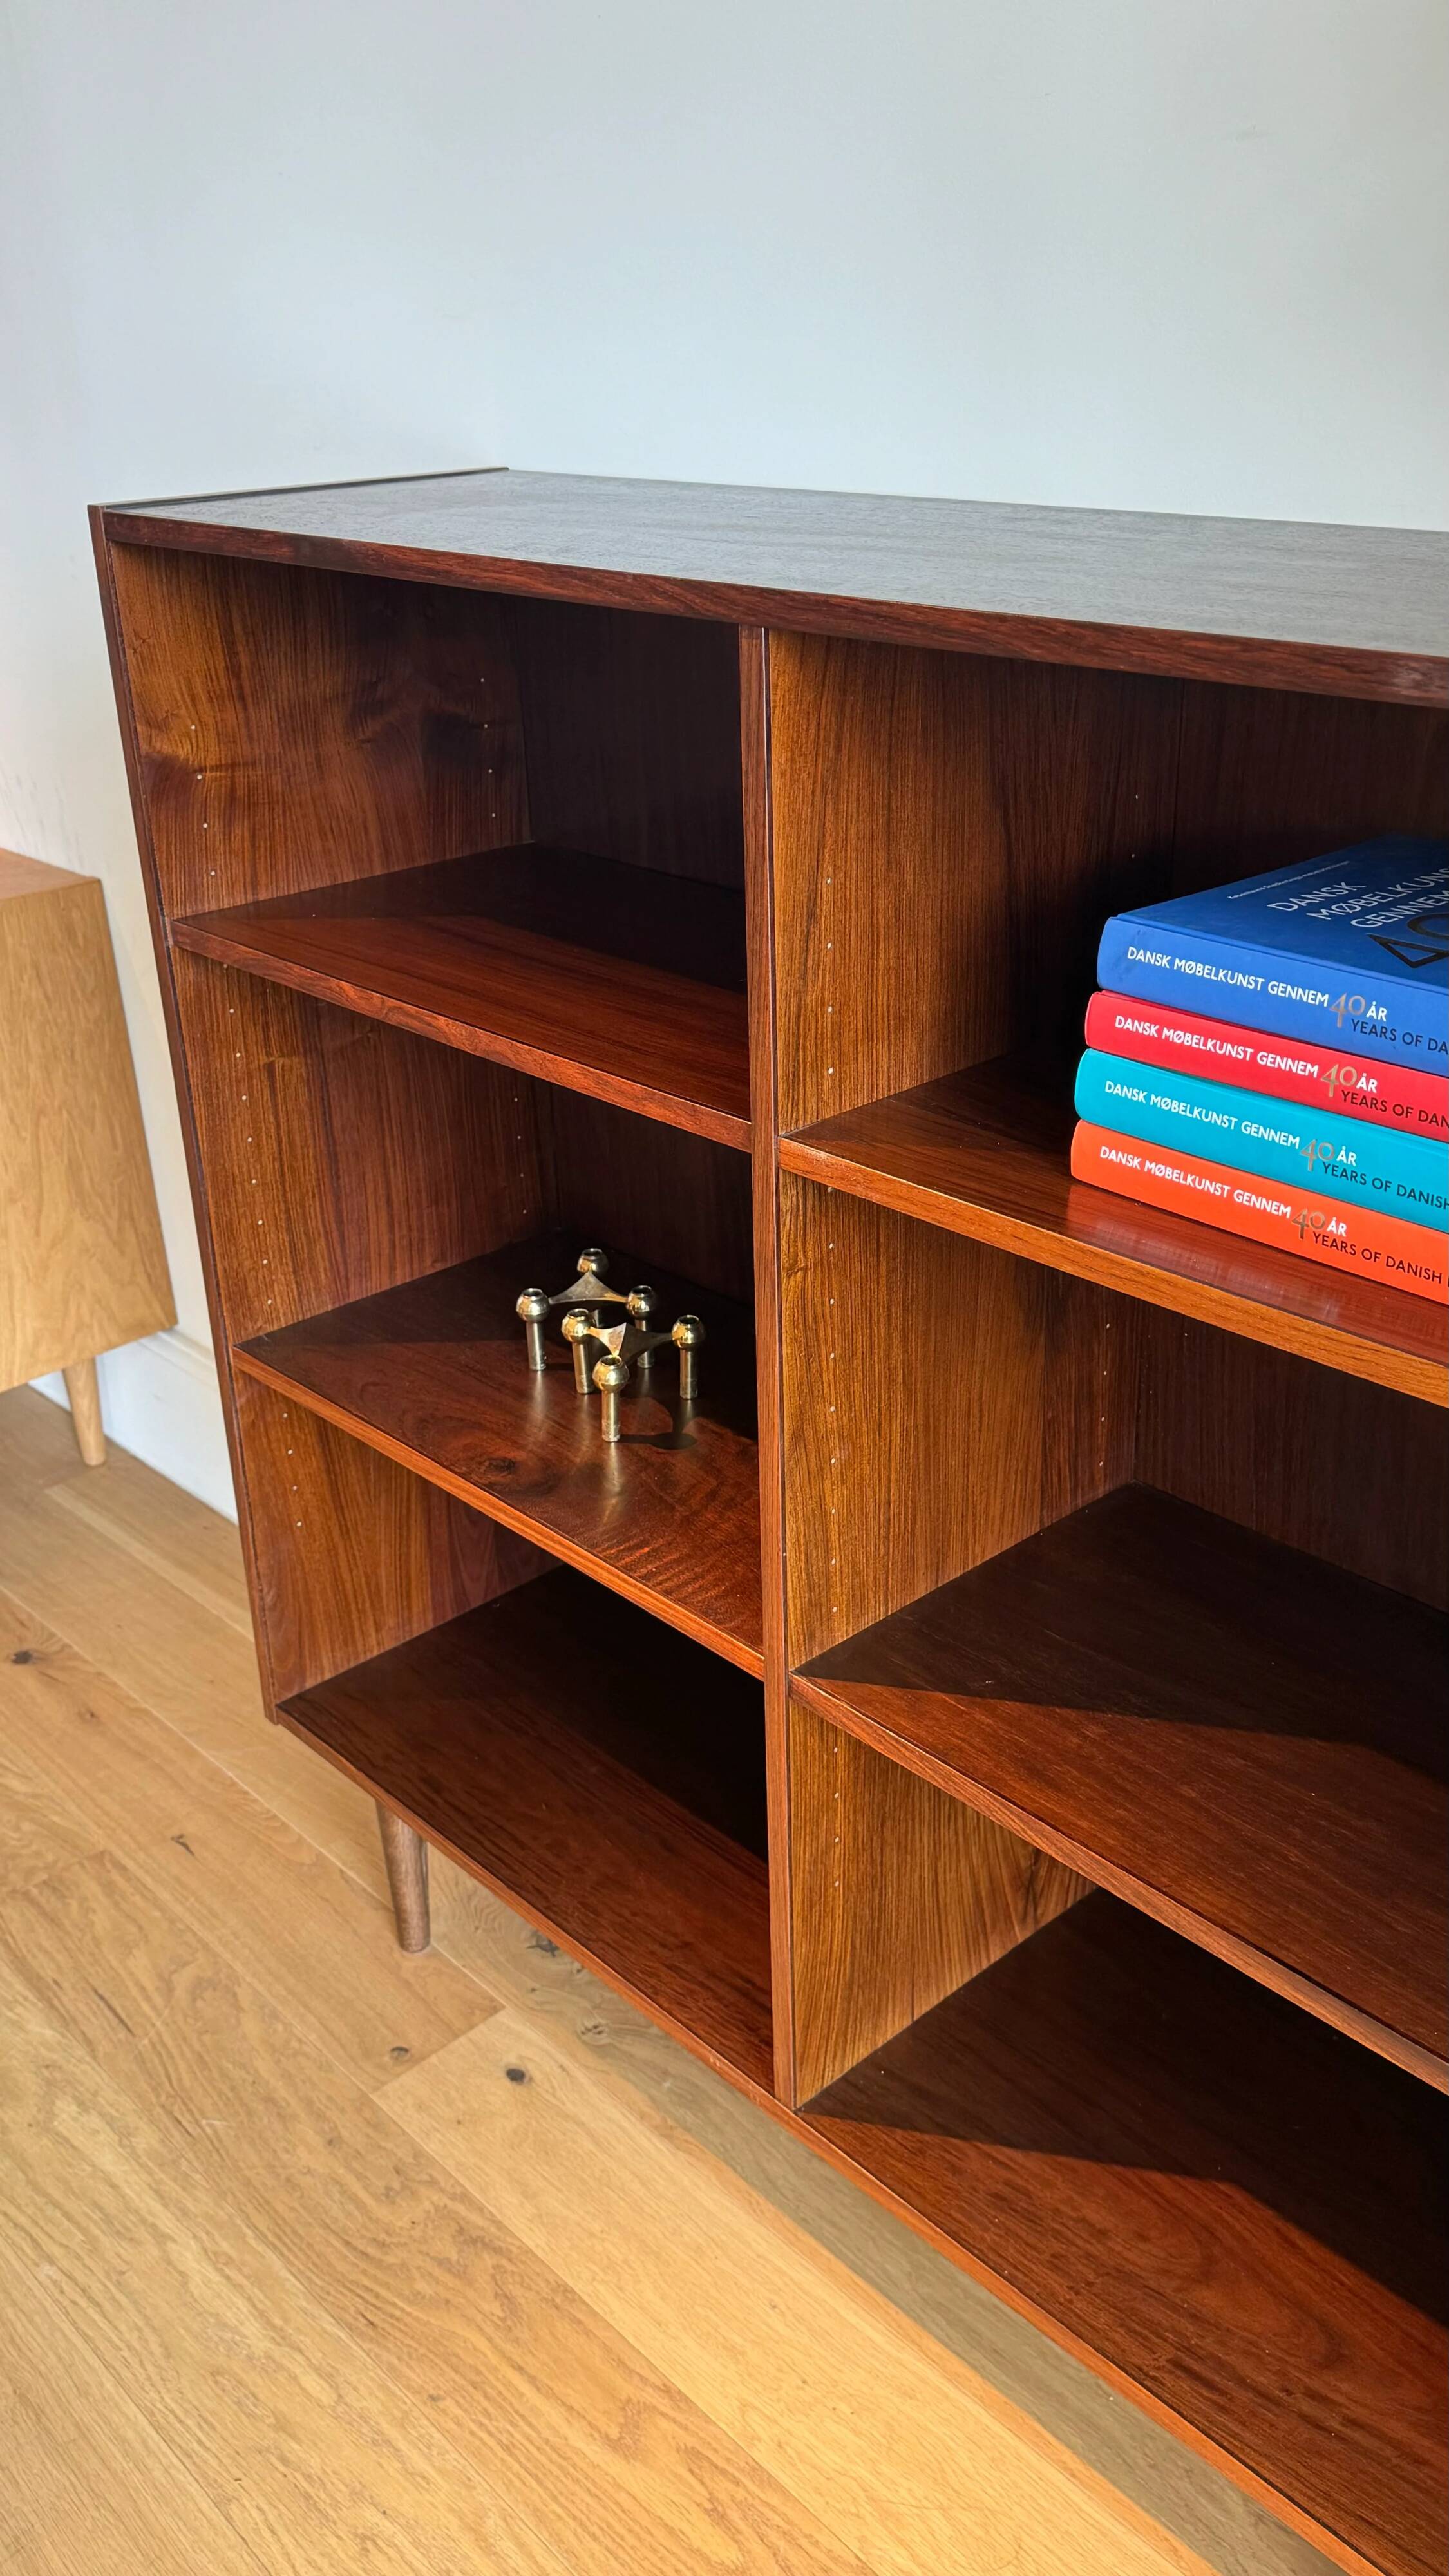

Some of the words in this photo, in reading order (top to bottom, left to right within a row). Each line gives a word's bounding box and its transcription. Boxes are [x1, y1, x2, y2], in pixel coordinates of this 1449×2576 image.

[1267, 881, 1367, 911] DANSK
[1127, 946, 1171, 968] DANSK
[1174, 957, 1264, 991] MØBELKUNST
[1268, 981, 1329, 1007] GENNEM
[1329, 992, 1366, 1028] 40
[1366, 1001, 1387, 1021] ÅR
[1115, 1015, 1159, 1038] DANSK
[1162, 1027, 1254, 1061] MØBELKUNST
[1257, 1051, 1319, 1078] GENNEM
[1320, 1064, 1358, 1097] 40
[1356, 1073, 1378, 1093] ÅR
[1351, 1018, 1397, 1041] YEARS
[1402, 1032, 1423, 1047] OF
[1427, 1037, 1449, 1055] DA
[1104, 1081, 1147, 1104] DANSK
[1150, 1094, 1238, 1130] MØBELKUNST
[1241, 1121, 1300, 1150] GENNEM
[1299, 1139, 1334, 1172] 40
[1336, 1146, 1357, 1166] ÅR
[1341, 1090, 1387, 1112] YEARS
[1392, 1104, 1414, 1119] OF
[1100, 1146, 1142, 1170] DANSK
[1144, 1159, 1231, 1198] MØBELKUNST
[1233, 1189, 1291, 1218] GENNEM
[1292, 1208, 1325, 1240] 40
[1327, 1217, 1347, 1237] ÅR
[1322, 1162, 1367, 1185] YEARS
[1372, 1177, 1392, 1192] OF
[1312, 1231, 1356, 1256] YEARS
[1361, 1248, 1381, 1263] OF
[1386, 1255, 1443, 1285] DANISH
